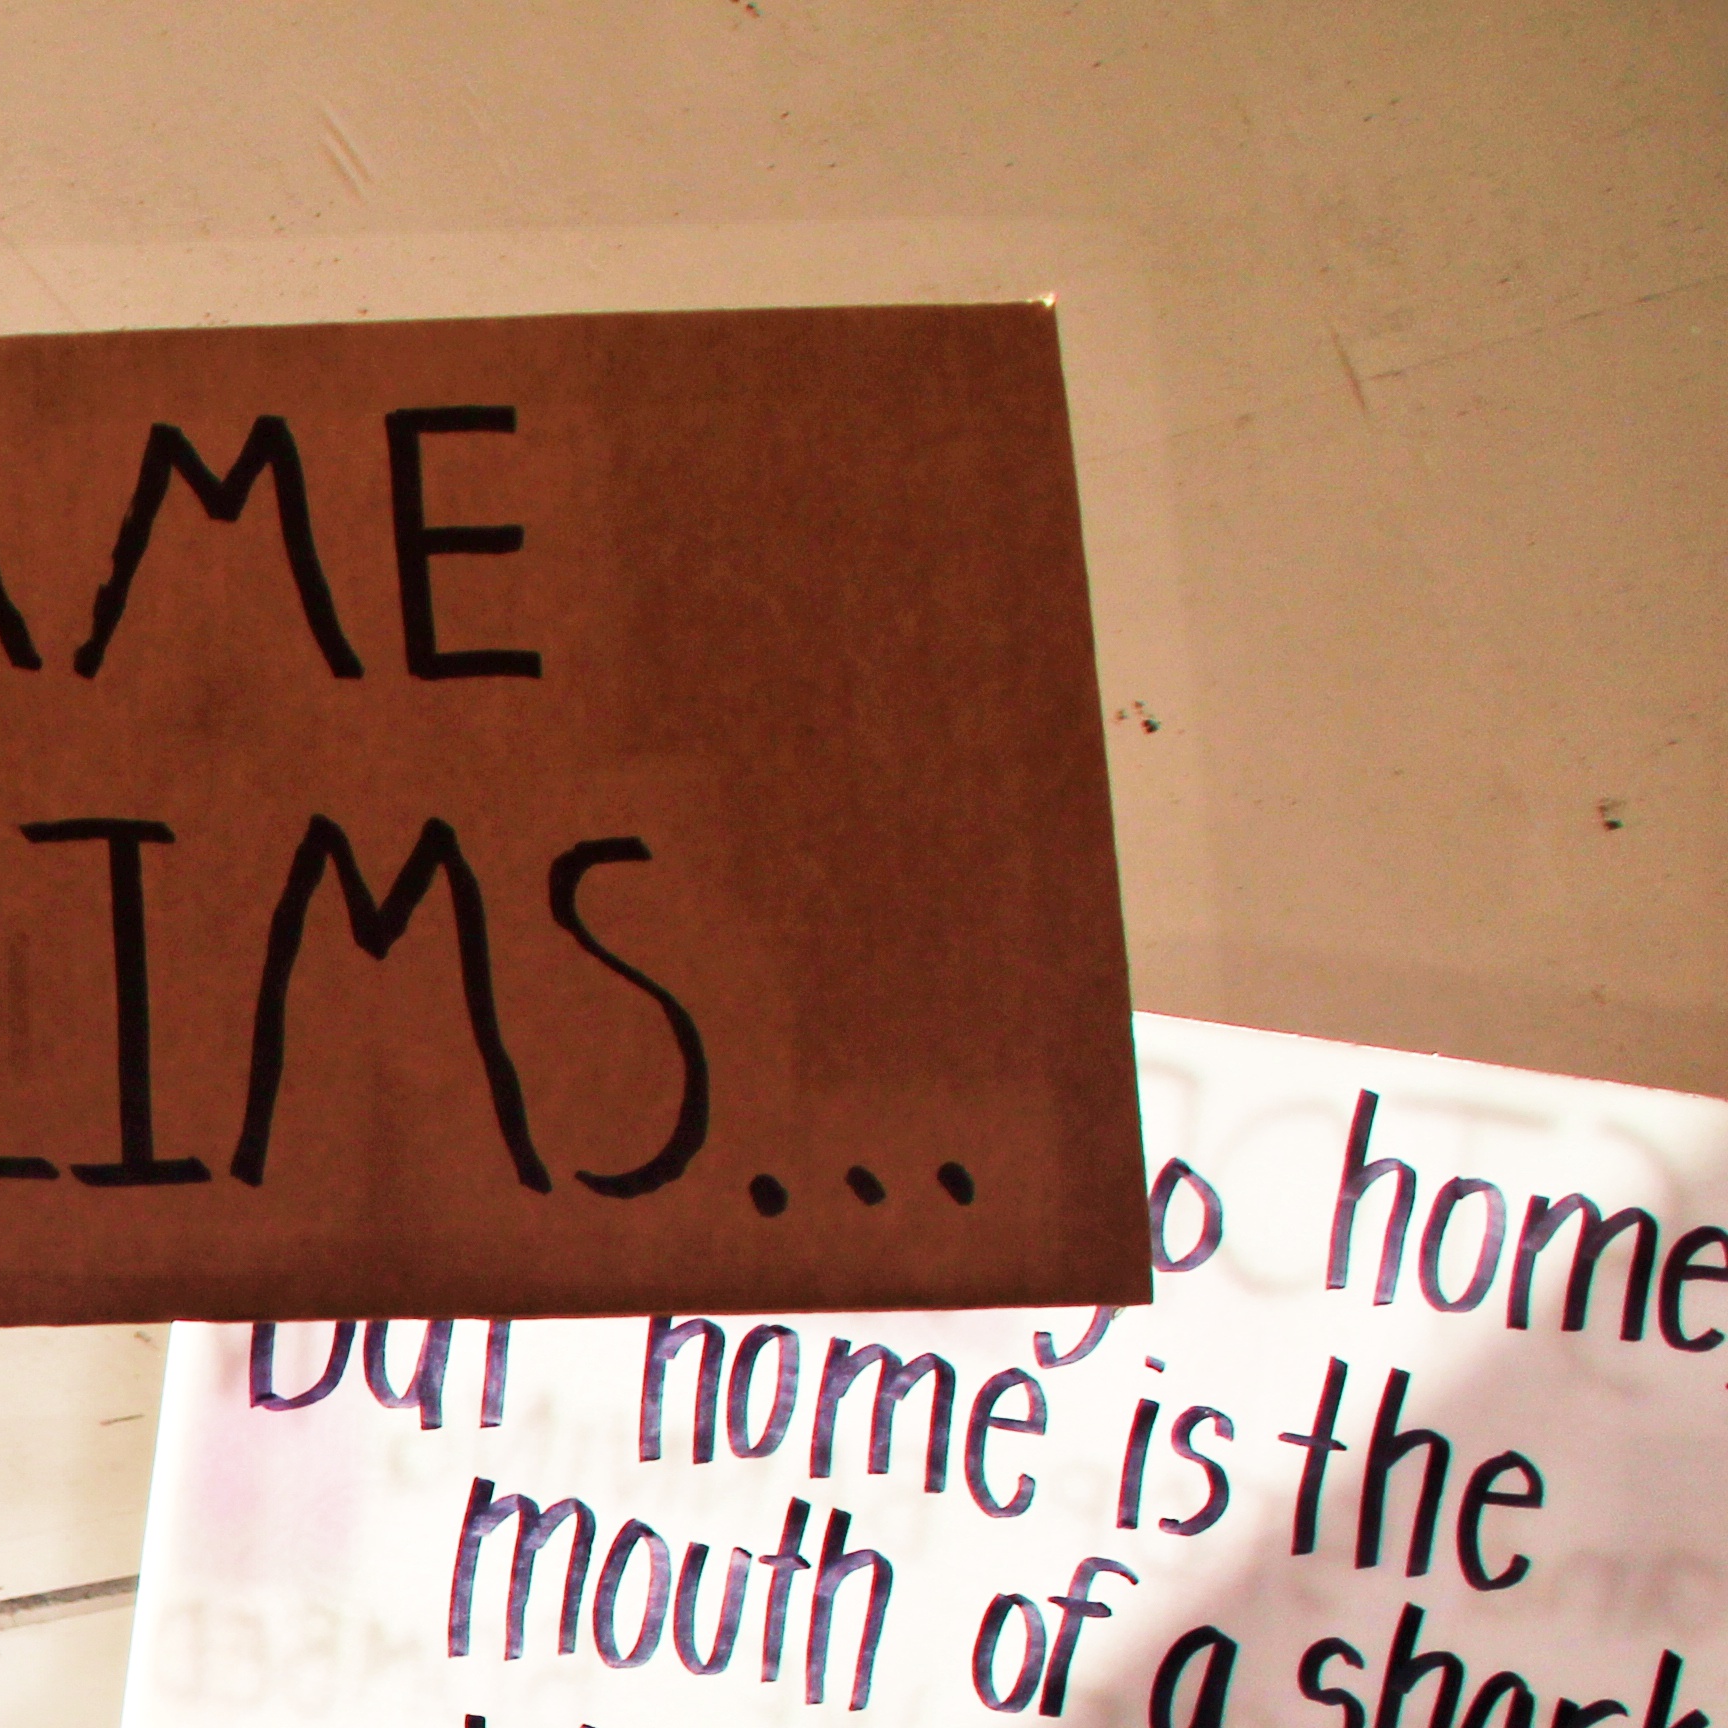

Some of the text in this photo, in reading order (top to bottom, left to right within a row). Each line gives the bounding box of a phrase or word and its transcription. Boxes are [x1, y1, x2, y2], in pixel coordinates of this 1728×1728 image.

[638, 1314, 1048, 1519] home
[1115, 1355, 1235, 1537] is
[1277, 1355, 1545, 1592] the
[447, 1476, 894, 1712] mouth
[970, 1556, 1140, 1718] of
